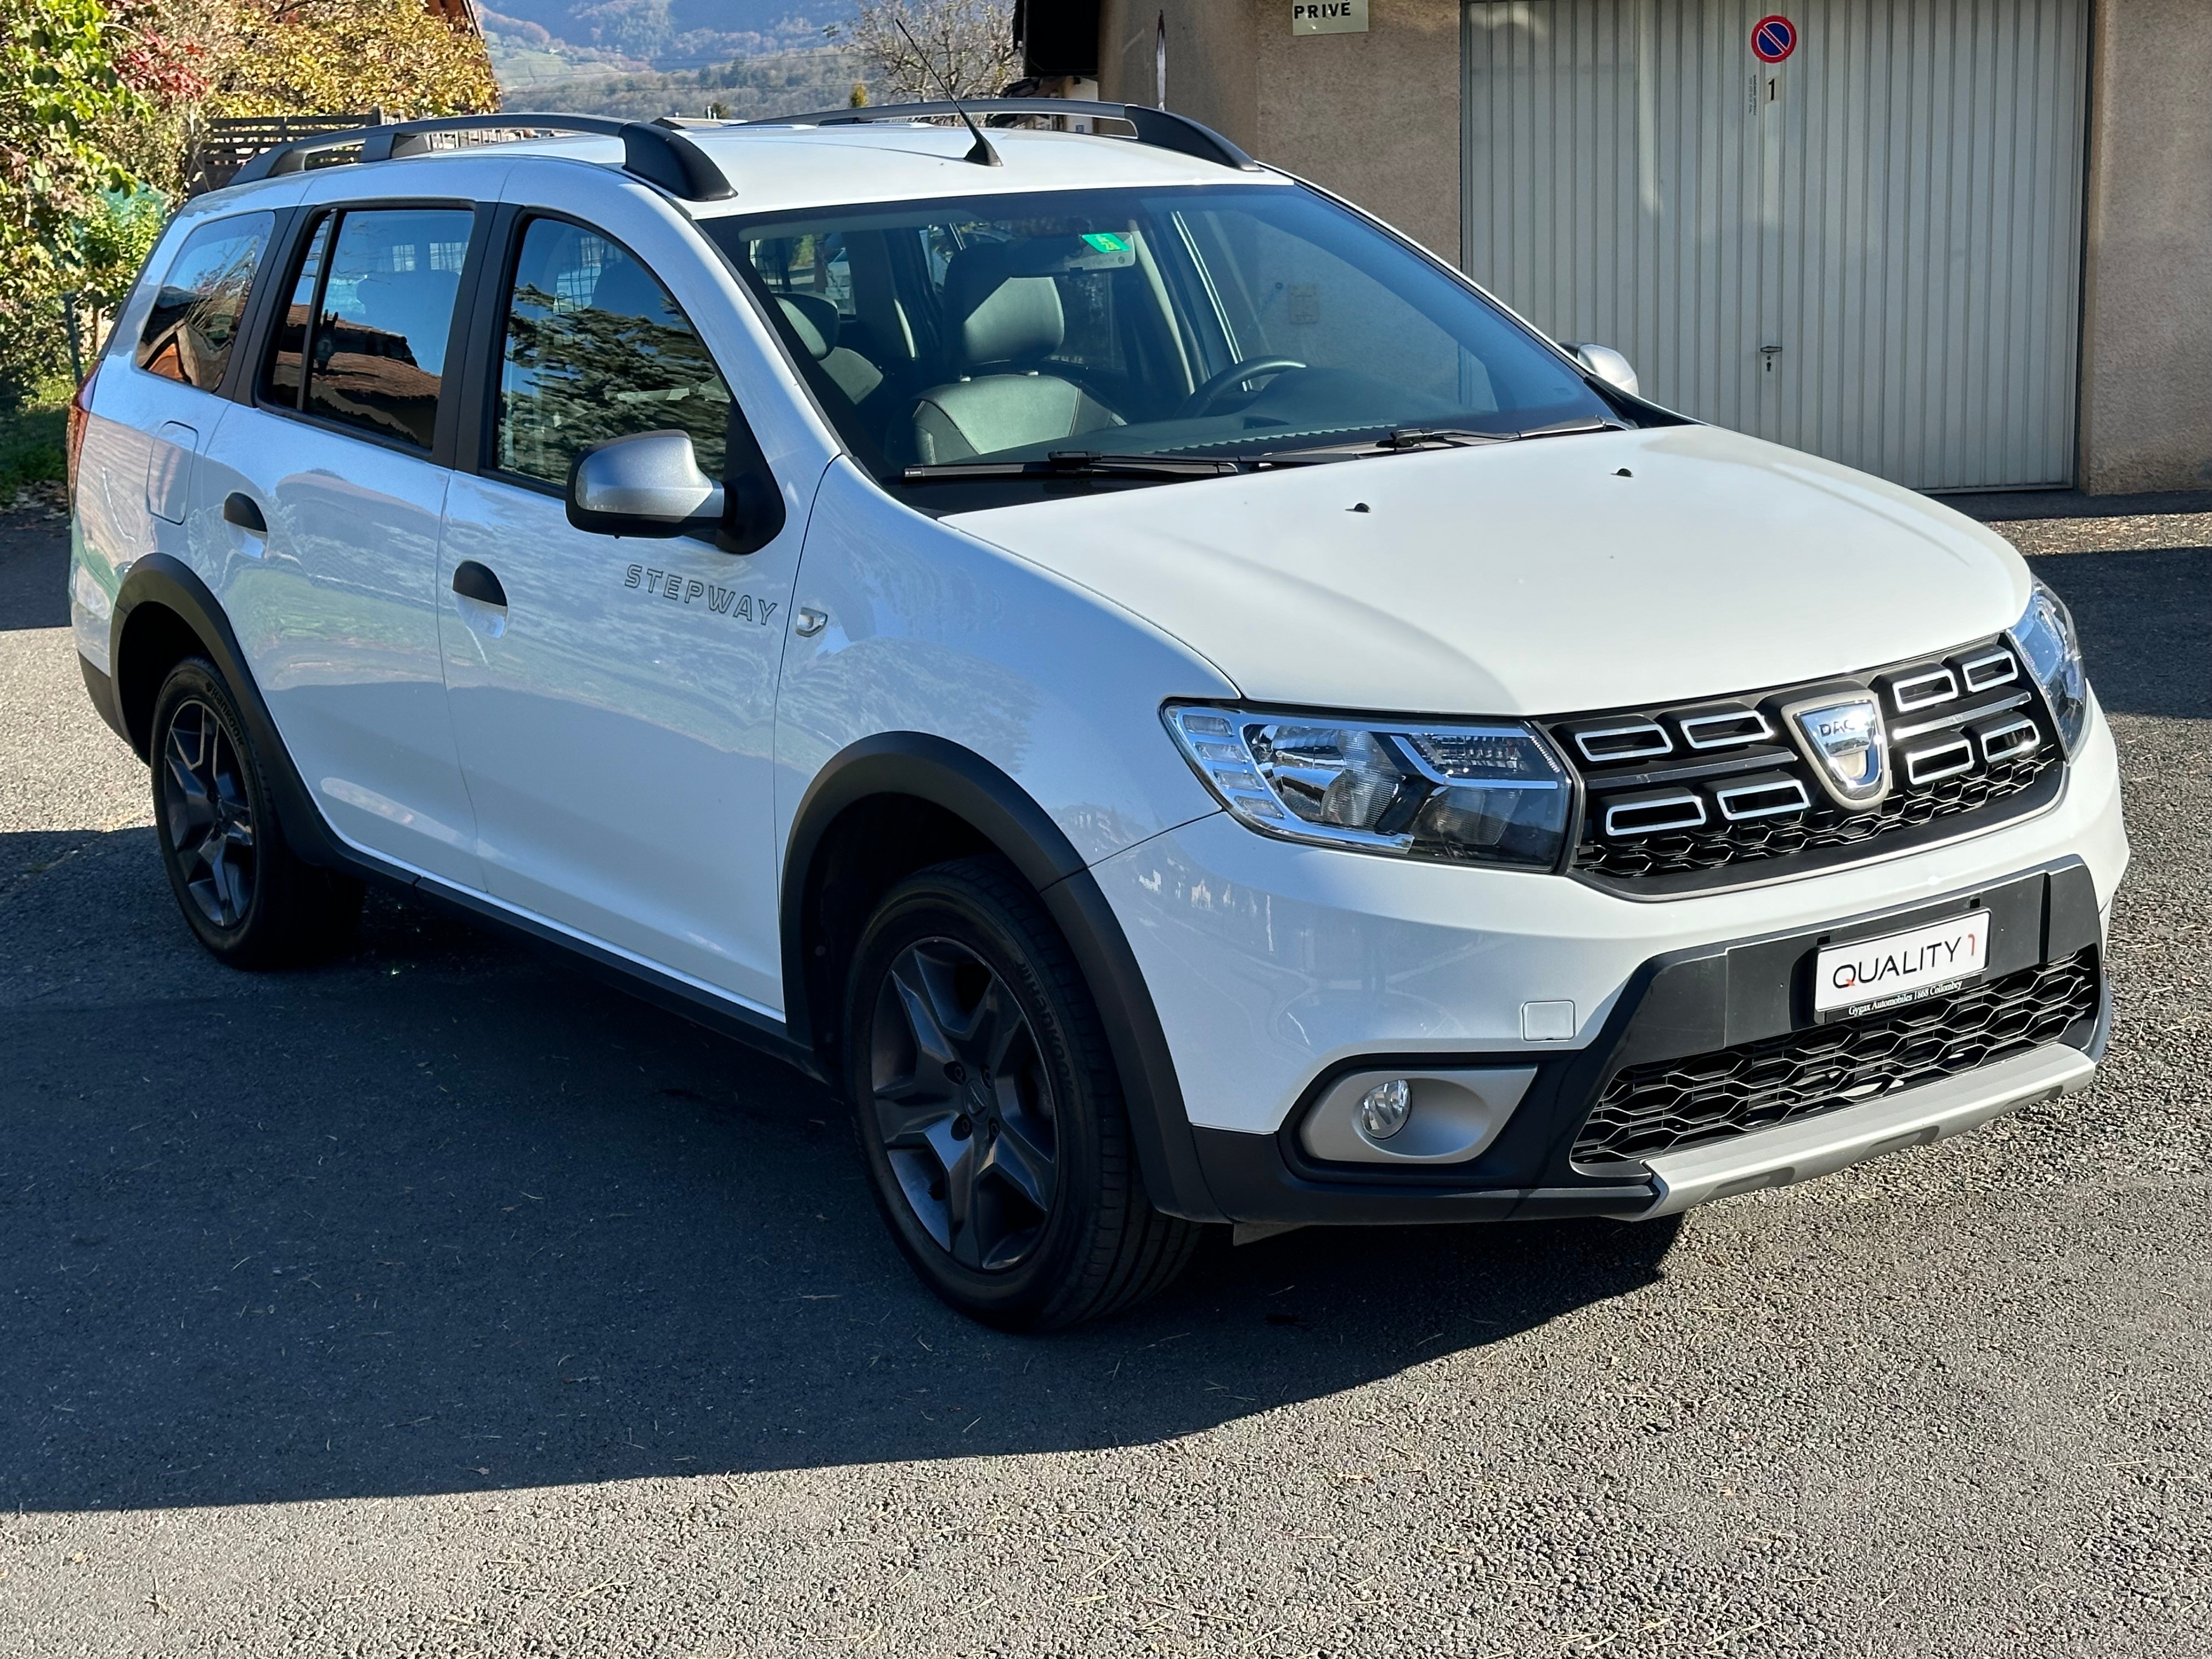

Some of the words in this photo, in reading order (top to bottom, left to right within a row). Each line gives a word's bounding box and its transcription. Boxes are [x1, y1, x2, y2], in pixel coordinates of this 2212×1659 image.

[1768, 78, 1775, 101] 1
[624, 564, 778, 626] STEPWAY
[1818, 718, 1866, 737] DAC
[1832, 936, 1962, 989] QUALITY
[1968, 934, 1976, 956] 1
[1848, 1004, 1871, 1017] Gygax
[1871, 993, 1913, 1011] Automobiles
[1914, 987, 1929, 1000] 1868
[1930, 980, 1963, 996] Collombey
